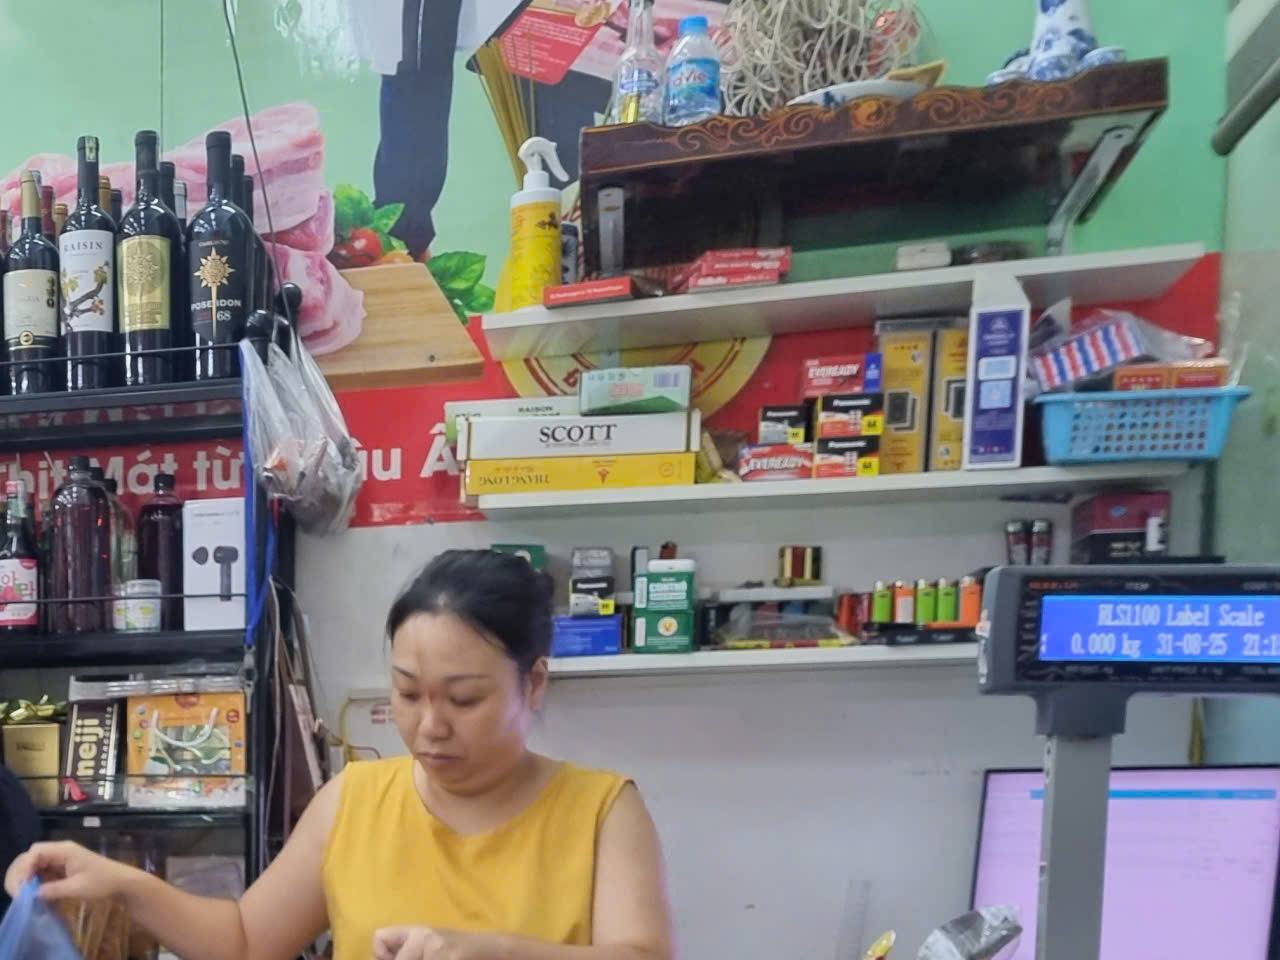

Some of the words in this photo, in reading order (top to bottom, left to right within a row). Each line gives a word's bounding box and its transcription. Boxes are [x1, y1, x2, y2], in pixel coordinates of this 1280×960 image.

[808, 363, 860, 379] EVEREADY
[539, 424, 618, 443] SCOTT
[1166, 604, 1210, 626] Label
[1219, 604, 1265, 626] Scale
[1071, 633, 1116, 655] 0.000
[1122, 633, 1142, 657] kg
